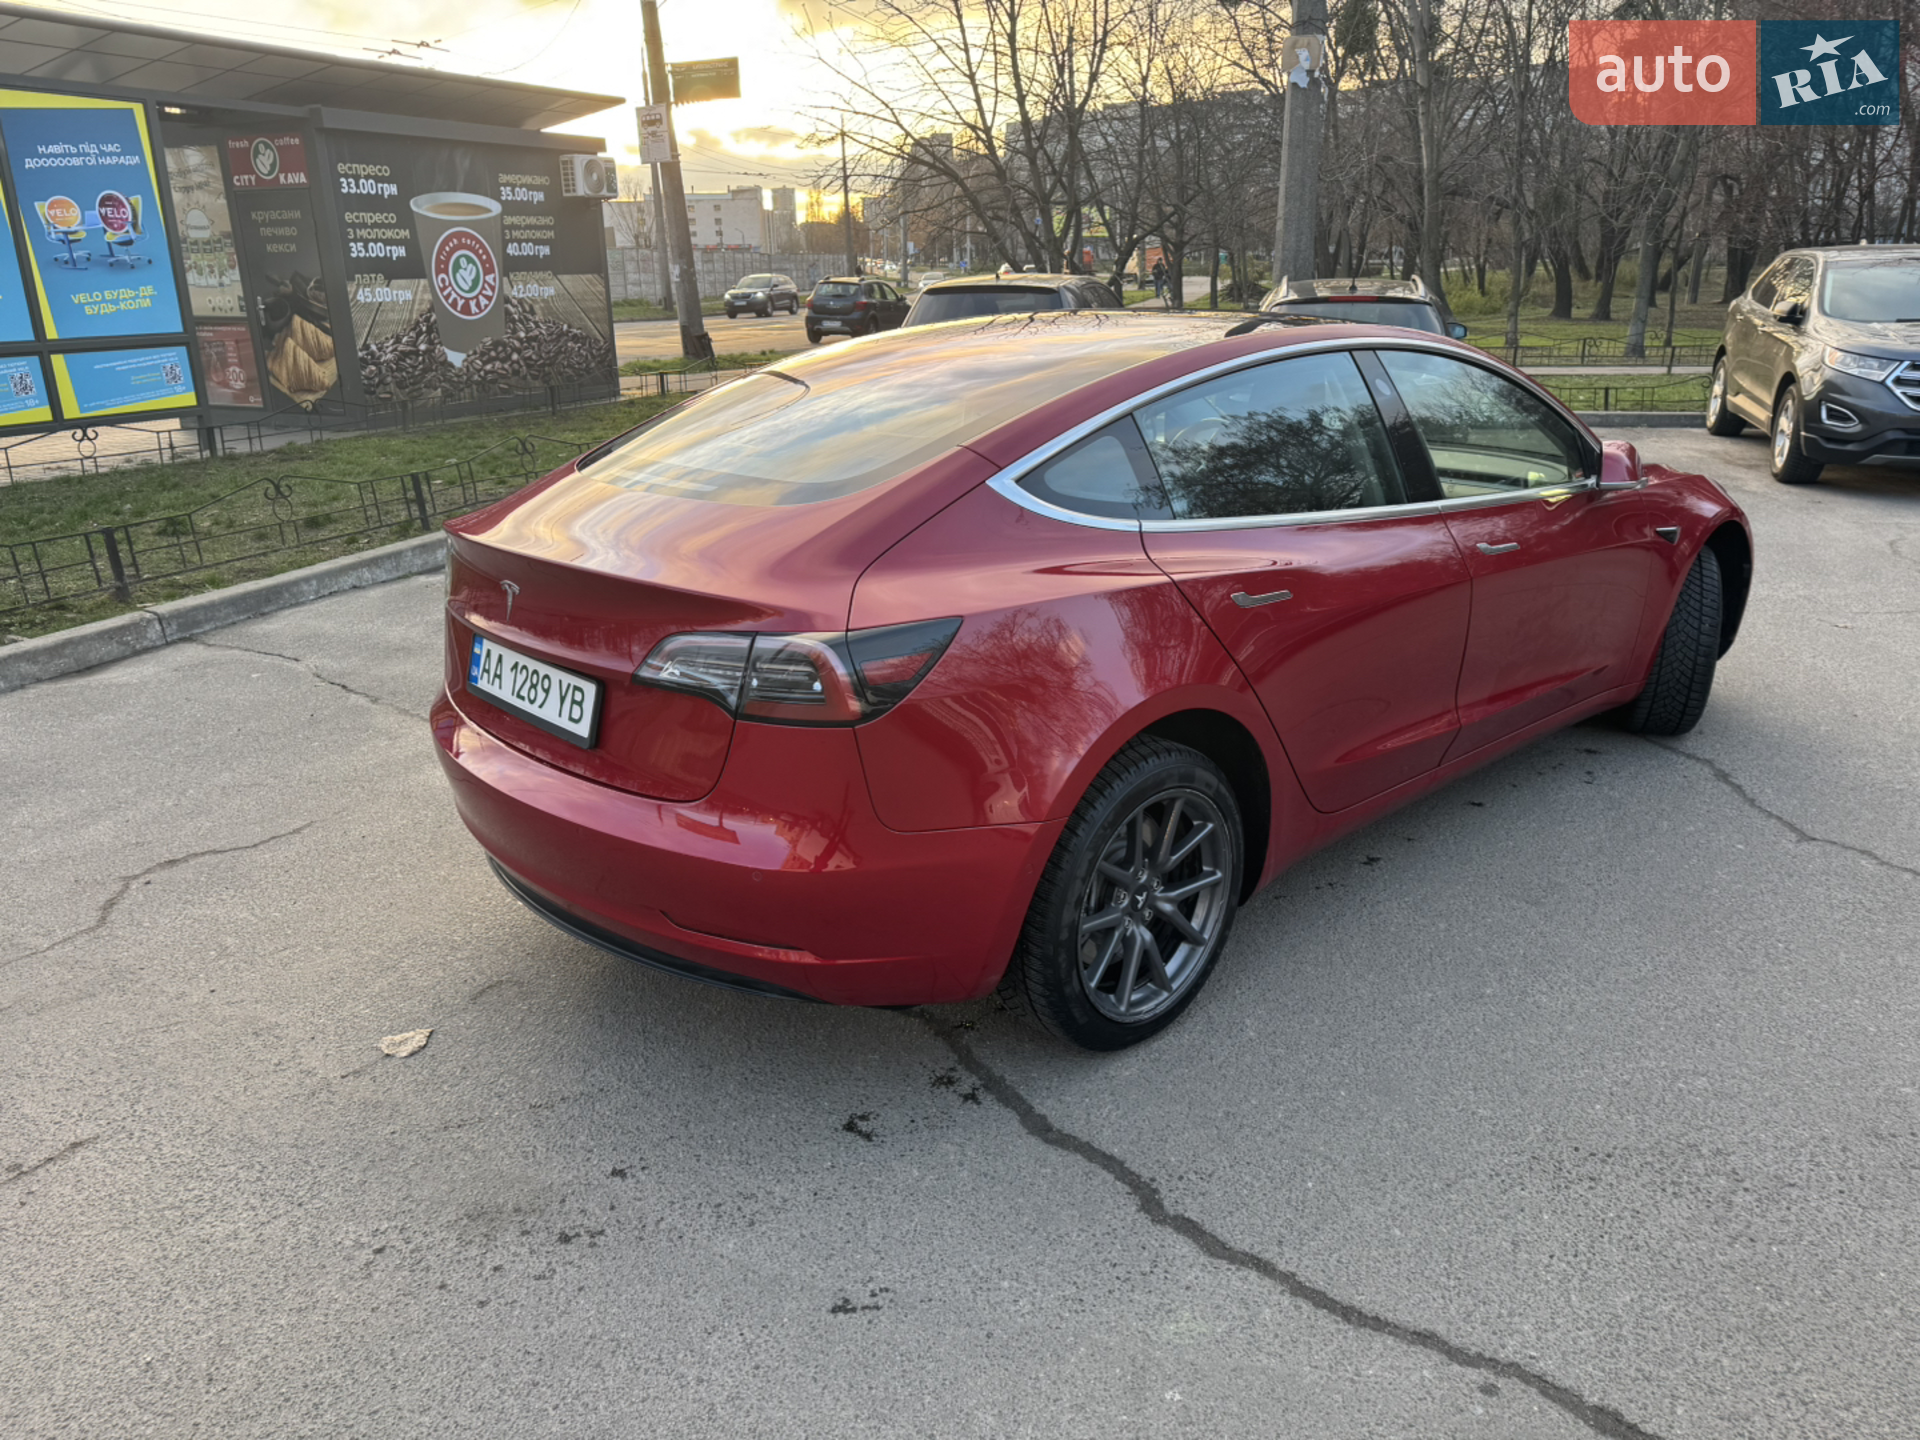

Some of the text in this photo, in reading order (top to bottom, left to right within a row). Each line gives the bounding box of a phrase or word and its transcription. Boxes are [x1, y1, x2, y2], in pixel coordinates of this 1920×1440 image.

[100, 143, 122, 152] ЧАС
[228, 137, 300, 148] fresh coffee
[98, 155, 140, 166] НАРАДИ
[337, 162, 390, 177] еспресо
[233, 172, 307, 186] CITY KAVA
[498, 173, 550, 185] американо
[48, 207, 78, 217] VELO
[100, 207, 129, 218] VELO
[251, 209, 301, 223] круасани
[345, 211, 397, 226] еспресо
[503, 215, 554, 227] американо
[259, 226, 298, 237] печиво
[356, 228, 410, 239] молоком
[512, 230, 555, 239] молоком
[266, 242, 297, 252] кекси
[354, 273, 385, 284] лате
[70, 291, 102, 304] VELO
[437, 273, 496, 314] CITY KAVA
[84, 298, 152, 315] БУДЬ-КОЛИ
[480, 648, 585, 724] AA 1289 YB
